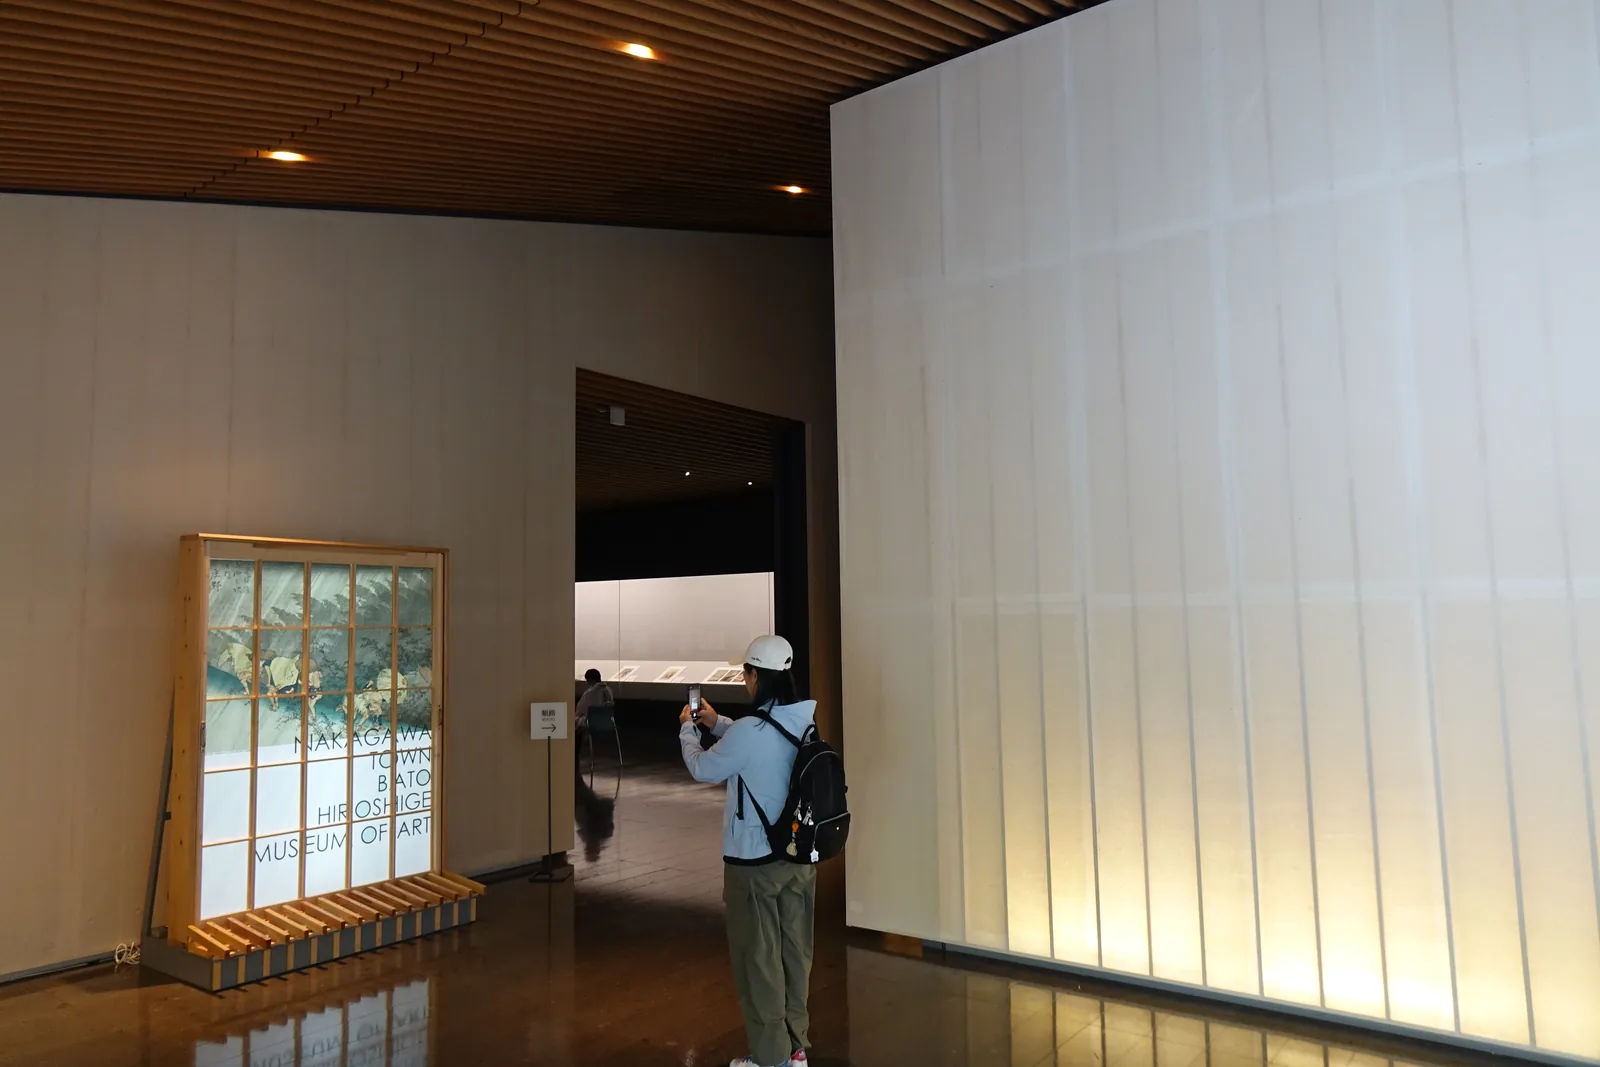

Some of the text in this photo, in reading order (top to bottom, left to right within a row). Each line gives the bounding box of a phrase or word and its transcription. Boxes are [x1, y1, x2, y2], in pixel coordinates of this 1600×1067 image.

[294, 725, 432, 753] NAKAGAWA
[371, 748, 431, 770] TOWN
[378, 769, 431, 792] BATO
[318, 791, 431, 825] HIROSHIGE
[255, 817, 431, 863] MUSEUM OF ART
